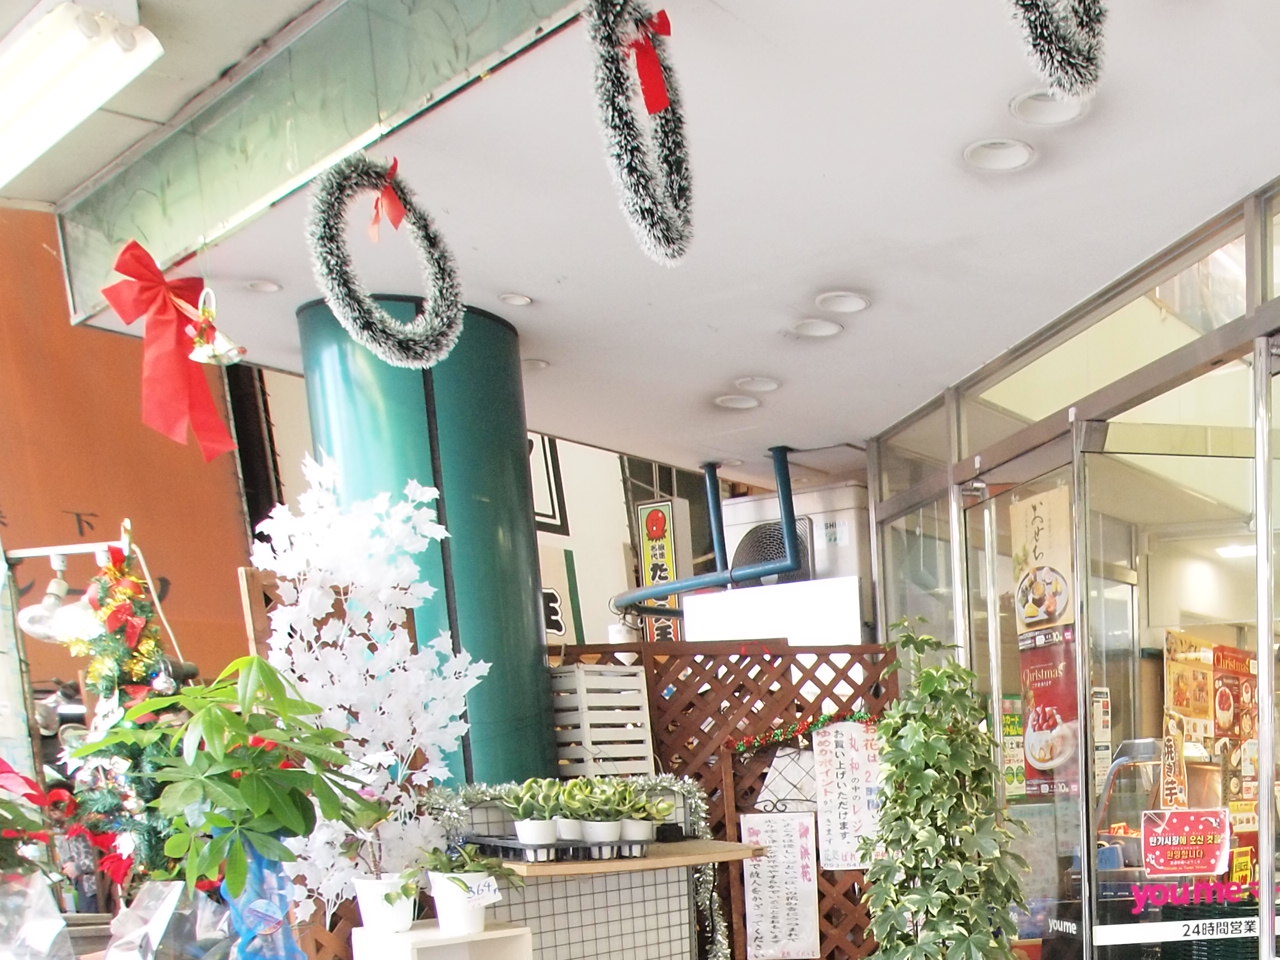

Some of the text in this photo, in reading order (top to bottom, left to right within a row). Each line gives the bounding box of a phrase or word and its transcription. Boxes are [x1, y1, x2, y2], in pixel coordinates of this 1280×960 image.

[1131, 882, 1243, 915] youme
[1048, 918, 1077, 935] youme
[1182, 919, 1257, 937] 24時間営業
